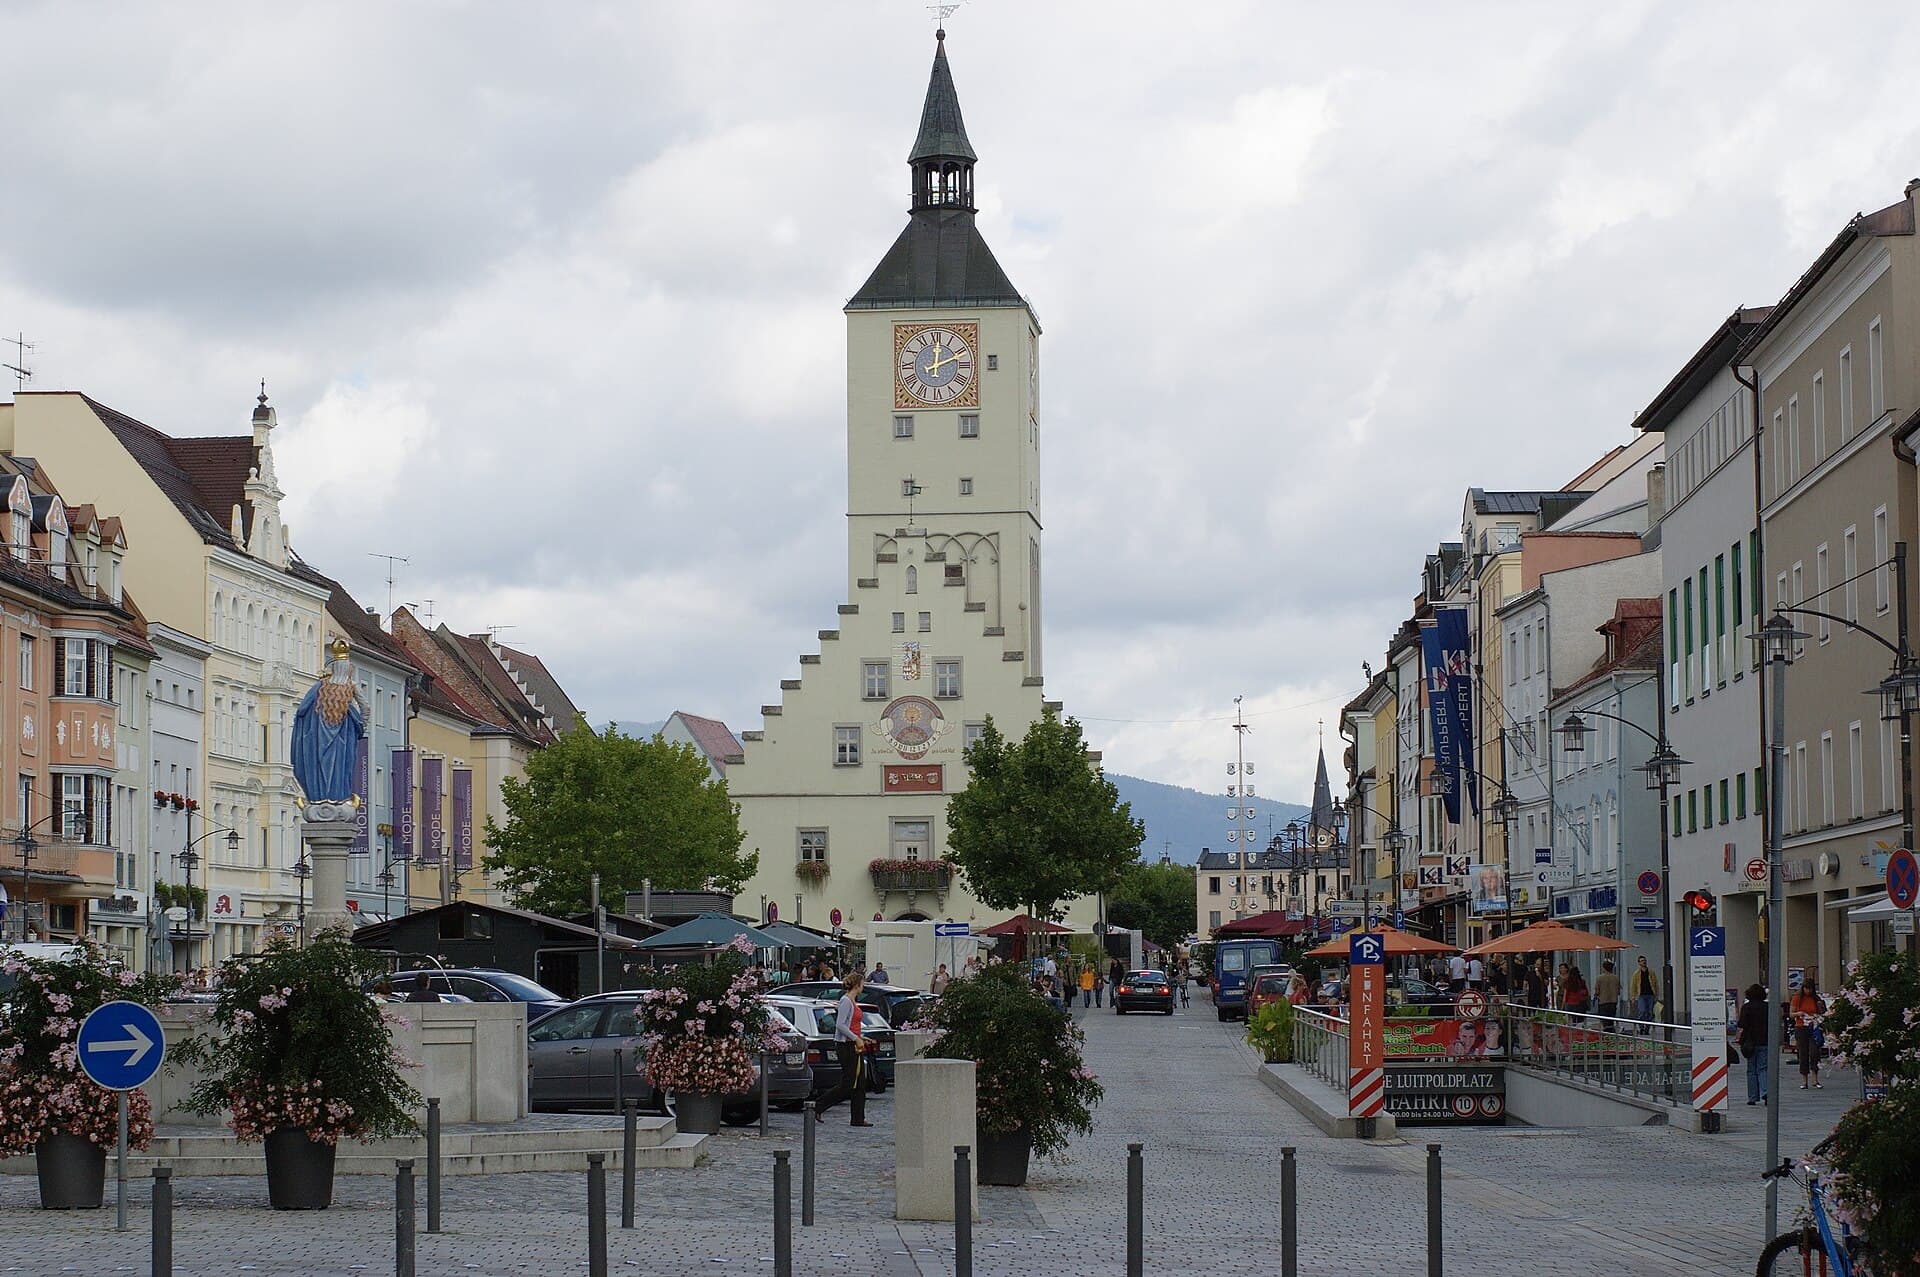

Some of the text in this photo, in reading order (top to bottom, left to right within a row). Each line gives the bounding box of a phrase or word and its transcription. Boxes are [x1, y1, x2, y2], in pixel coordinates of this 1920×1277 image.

[916, 335, 928, 348] XI
[906, 347, 918, 357] X
[959, 361, 970, 369] III
[357, 797, 367, 837] MODE
[402, 807, 412, 844] MODE
[431, 814, 441, 849] MODE
[462, 821, 471, 856] MODE
[1702, 935, 1713, 947] P
[1363, 944, 1374, 958] P
[1362, 967, 1372, 1065] ENFAHRT
[1397, 1074, 1494, 1088] LUITPOLDPLATZ
[1459, 1099, 1471, 1109] 10
